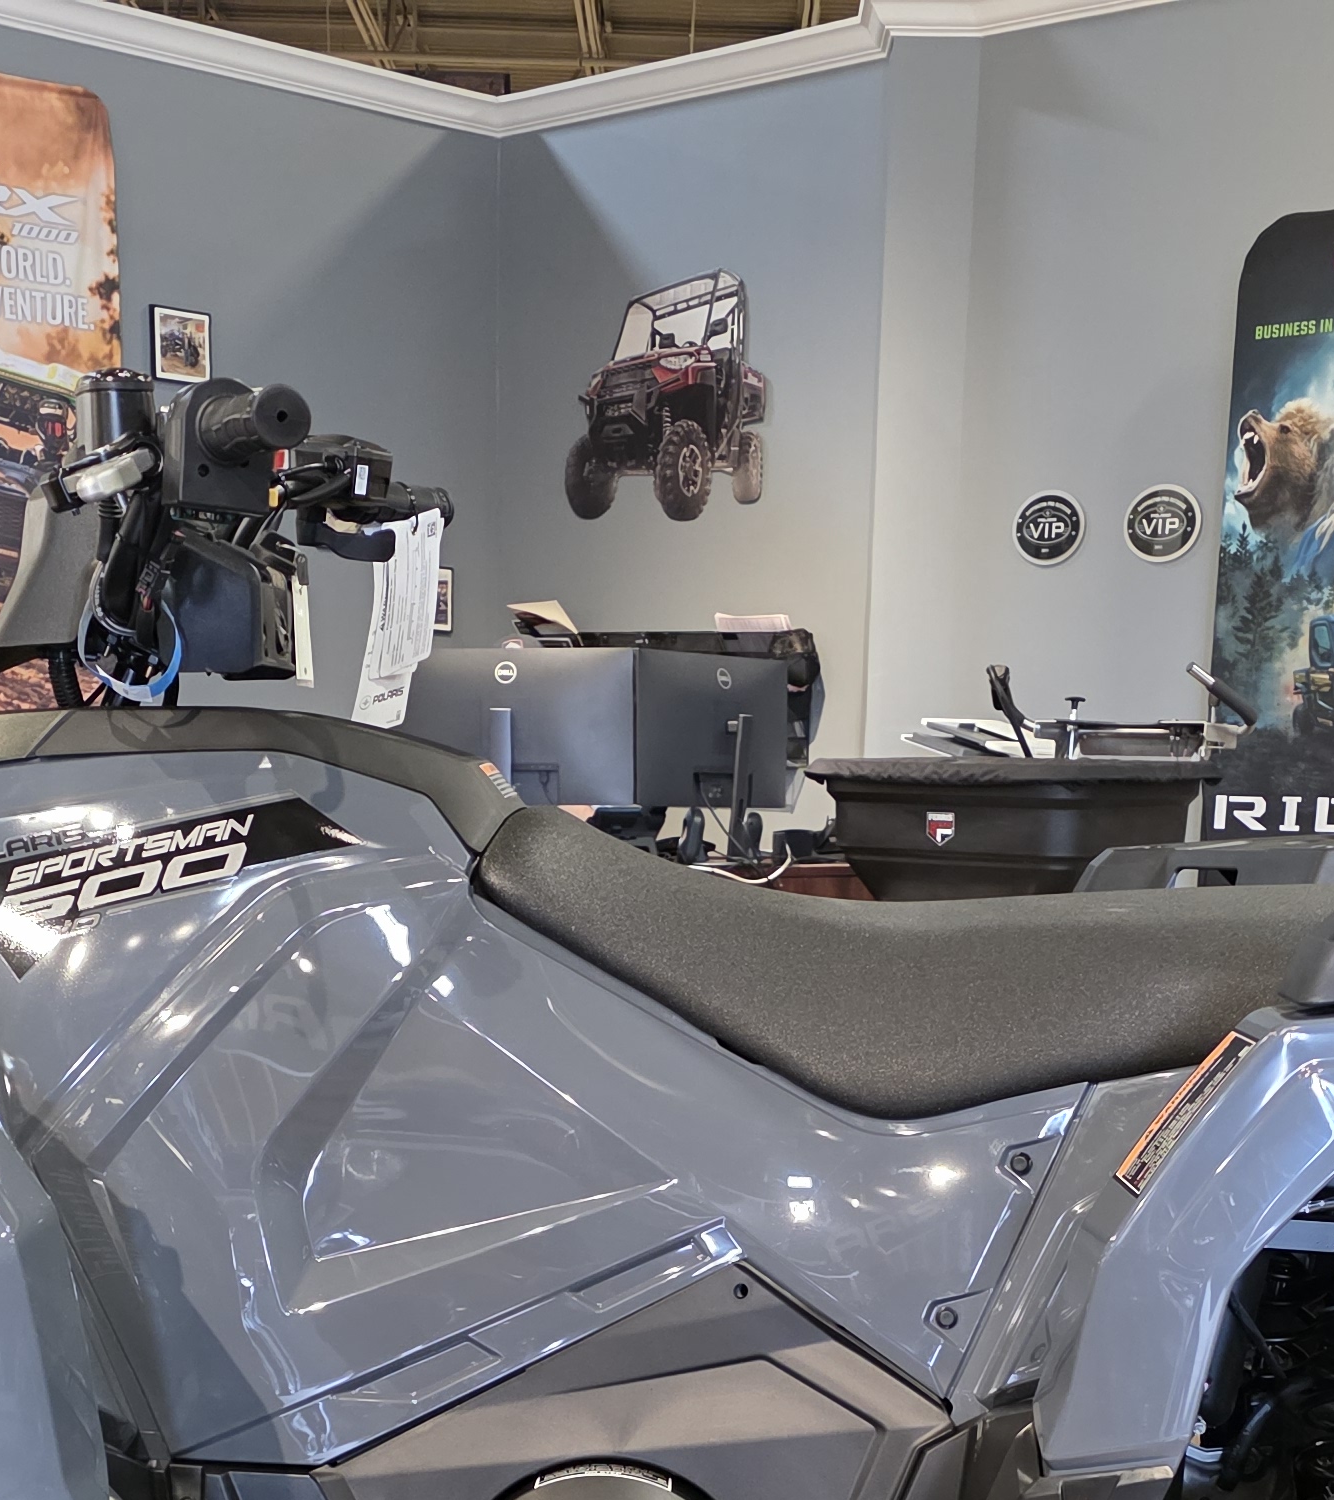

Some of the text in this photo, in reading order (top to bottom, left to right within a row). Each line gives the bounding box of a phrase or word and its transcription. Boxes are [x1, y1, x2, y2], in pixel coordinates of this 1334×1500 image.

[11, 222, 79, 244] 1000
[1255, 320, 1316, 340] BUSINESS
[1320, 319, 1333, 332] IN
[1029, 522, 1065, 539] VIP
[1142, 518, 1179, 535] VIP
[373, 686, 405, 705] POLARIS
[5, 814, 254, 892] SPORTSMAN
